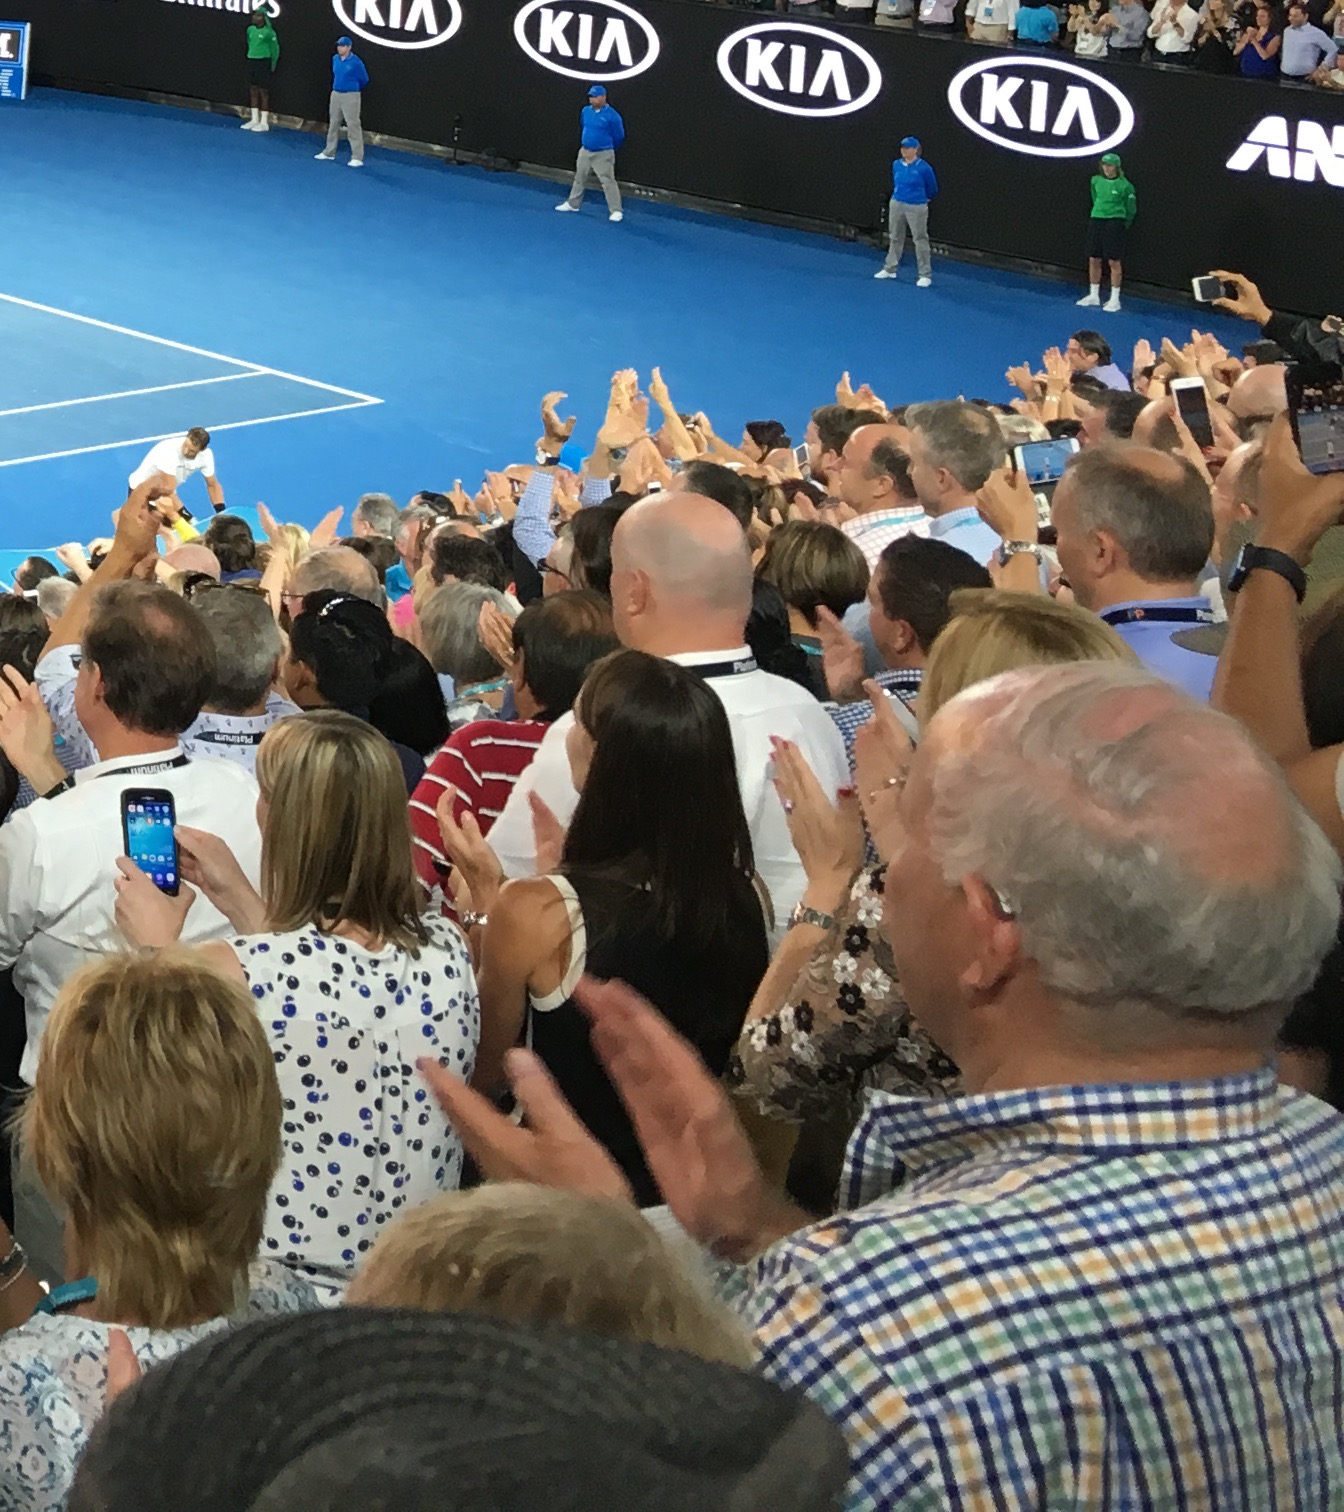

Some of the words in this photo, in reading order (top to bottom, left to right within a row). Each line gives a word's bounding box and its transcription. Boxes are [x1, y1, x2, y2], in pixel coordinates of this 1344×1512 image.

[538, 8, 633, 67] KIA
[745, 38, 852, 101] KIA
[980, 73, 1100, 141] KIA
[129, 761, 174, 775] Platinum
[214, 733, 254, 744] Platinum
